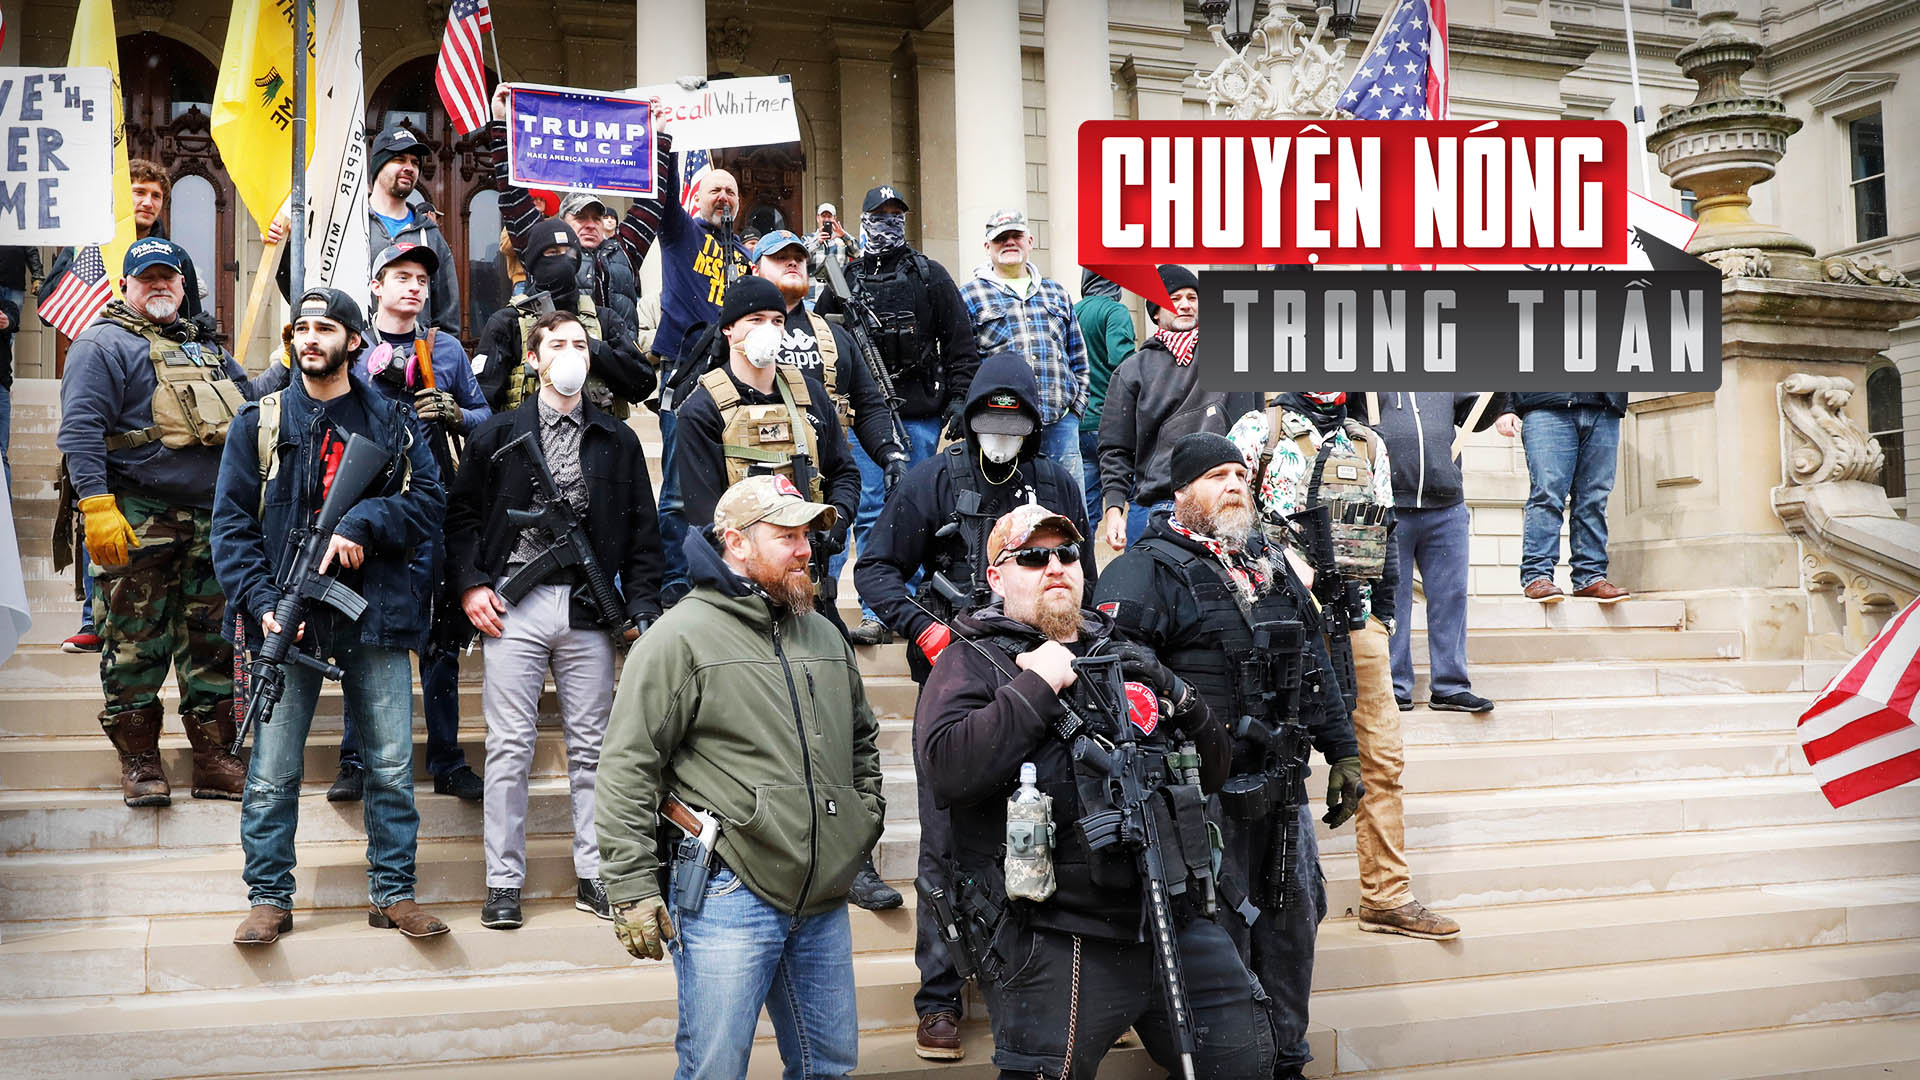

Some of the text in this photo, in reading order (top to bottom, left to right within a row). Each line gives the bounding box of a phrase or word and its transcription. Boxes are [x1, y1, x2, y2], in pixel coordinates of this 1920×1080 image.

[48, 73, 94, 121] THE
[713, 90, 791, 115] Whitmer
[518, 113, 645, 142] TRUMP
[530, 136, 633, 156] PENCE
[526, 152, 637, 167] MAKE AMERICA GREAT AGAIN!
[775, 346, 825, 369] Kapp
